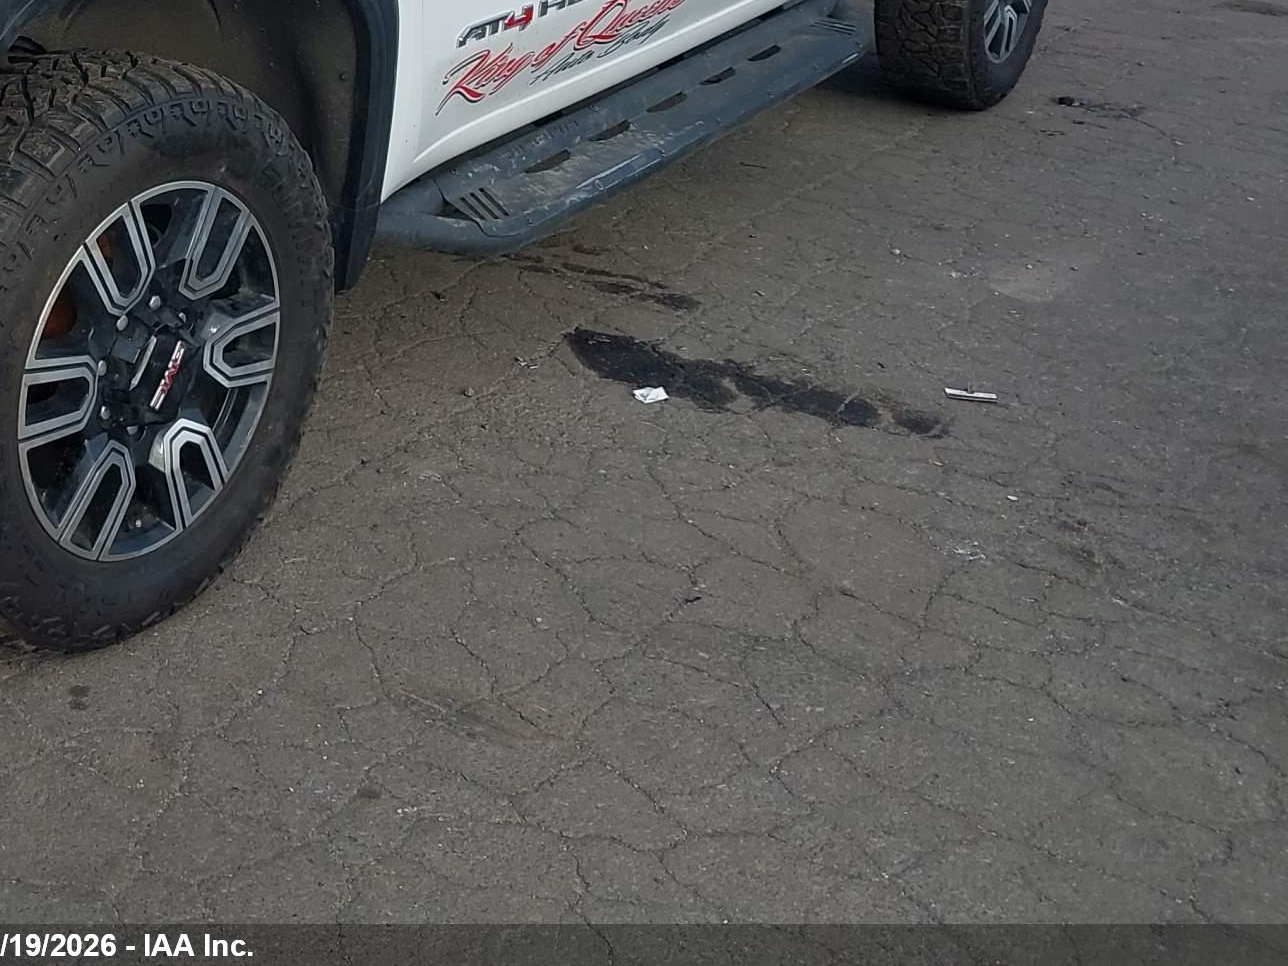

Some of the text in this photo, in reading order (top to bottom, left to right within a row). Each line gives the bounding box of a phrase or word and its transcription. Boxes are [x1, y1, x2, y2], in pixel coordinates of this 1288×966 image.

[456, 3, 534, 49] AT4
[435, 42, 536, 116] King
[531, 20, 587, 72] of
